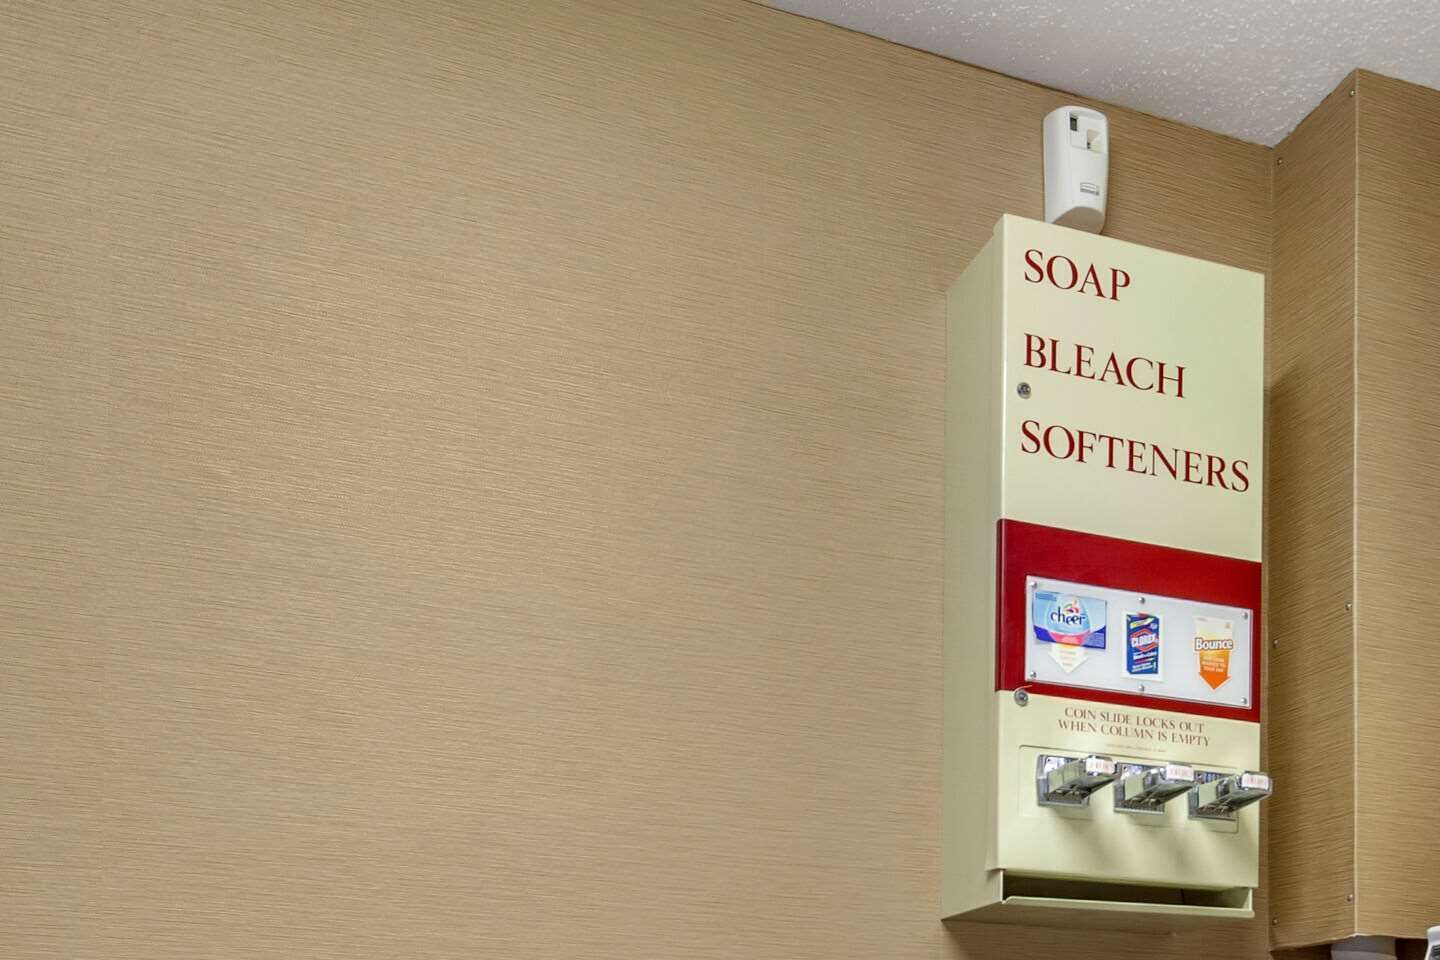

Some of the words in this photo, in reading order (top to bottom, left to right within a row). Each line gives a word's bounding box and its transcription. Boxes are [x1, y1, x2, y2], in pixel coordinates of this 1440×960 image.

[1024, 249, 1130, 301] SOAP
[1024, 333, 1185, 398] BLEACH
[1021, 420, 1249, 493] SOFTENERS
[1050, 606, 1086, 626] cheer
[1194, 637, 1233, 651] Bounce
[1058, 719, 1097, 733] WHEN
[1101, 724, 1153, 739] COLUMN
[1158, 731, 1168, 742] IS
[1172, 732, 1211, 747] EMPTY
[1064, 706, 1097, 720] COIN
[1100, 711, 1134, 725] SLIDE
[1136, 715, 1176, 729] LOCKS
[1179, 721, 1205, 733] OUT
